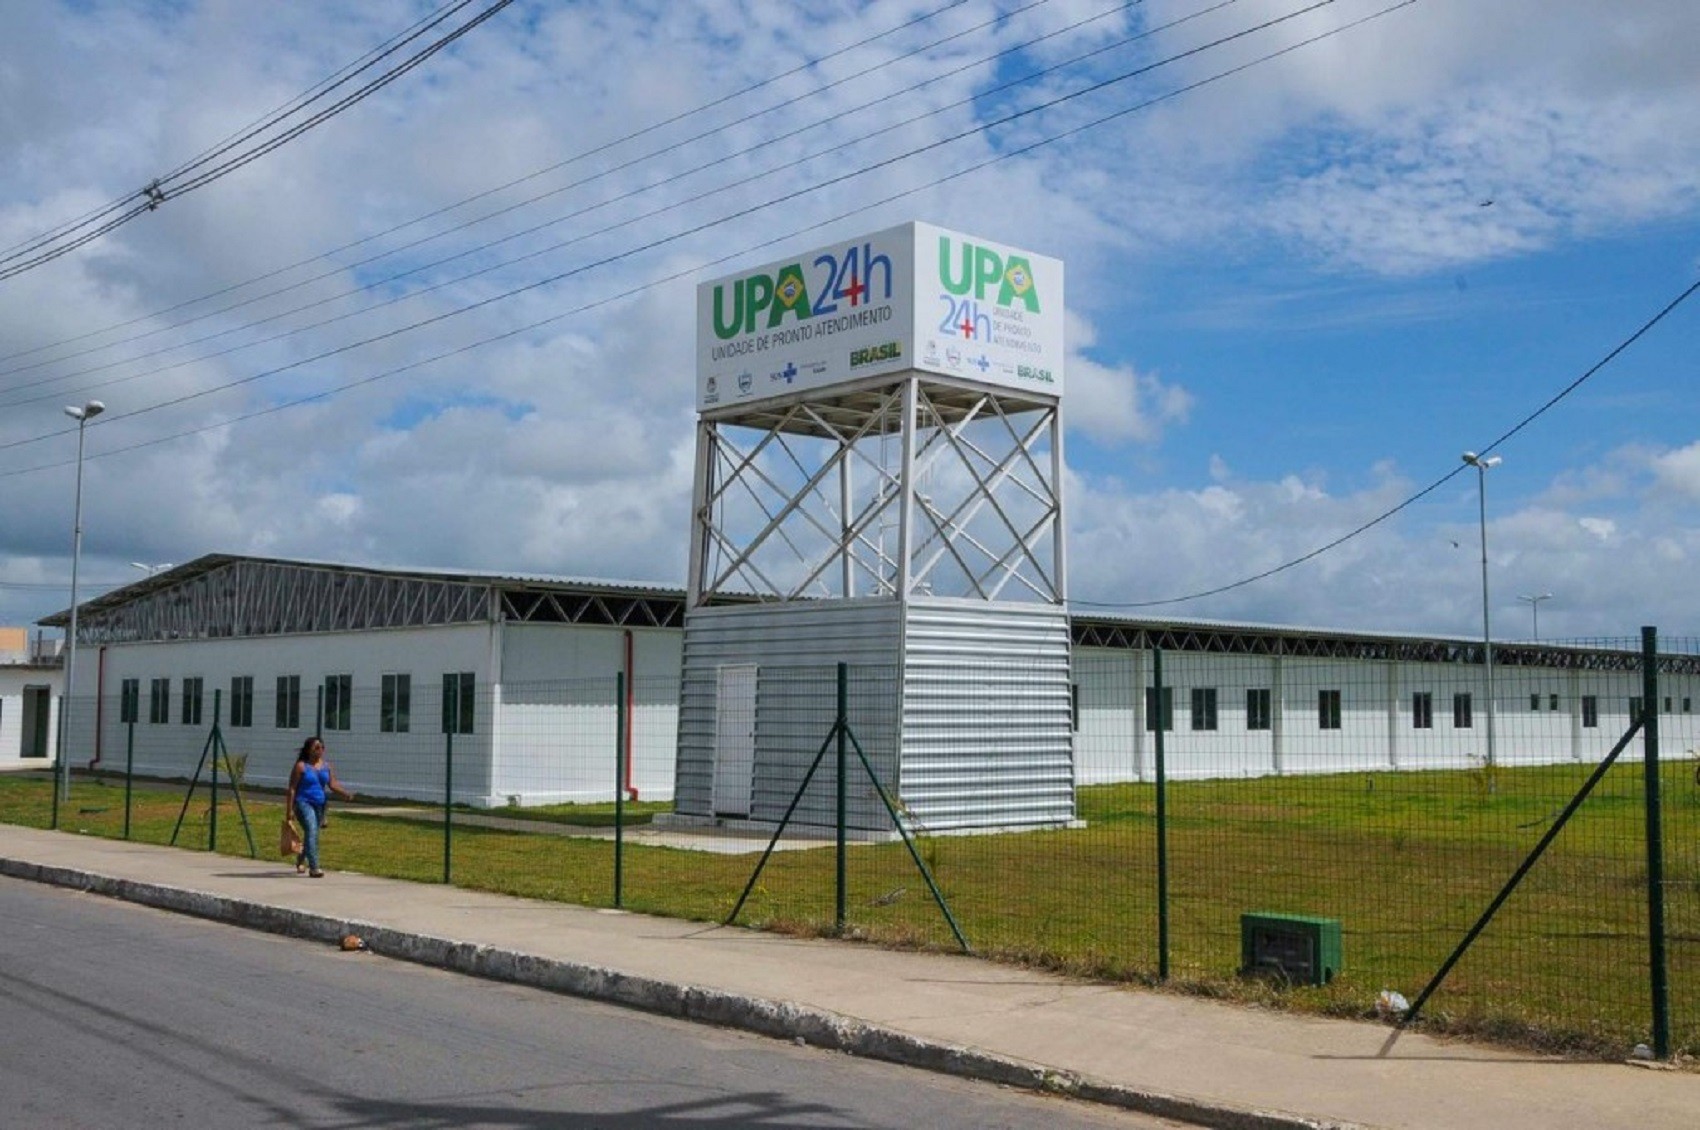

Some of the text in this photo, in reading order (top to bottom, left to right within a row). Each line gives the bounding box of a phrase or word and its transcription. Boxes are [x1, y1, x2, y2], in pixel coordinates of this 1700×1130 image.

[713, 243, 891, 339] UPA 24h
[939, 236, 1040, 314] UPA
[712, 305, 892, 361] UNIDADE DE PRONTO ATENDIMENTO
[939, 294, 992, 343] 24h
[850, 342, 901, 366] BRASIL
[1017, 365, 1054, 383] BRASIL
